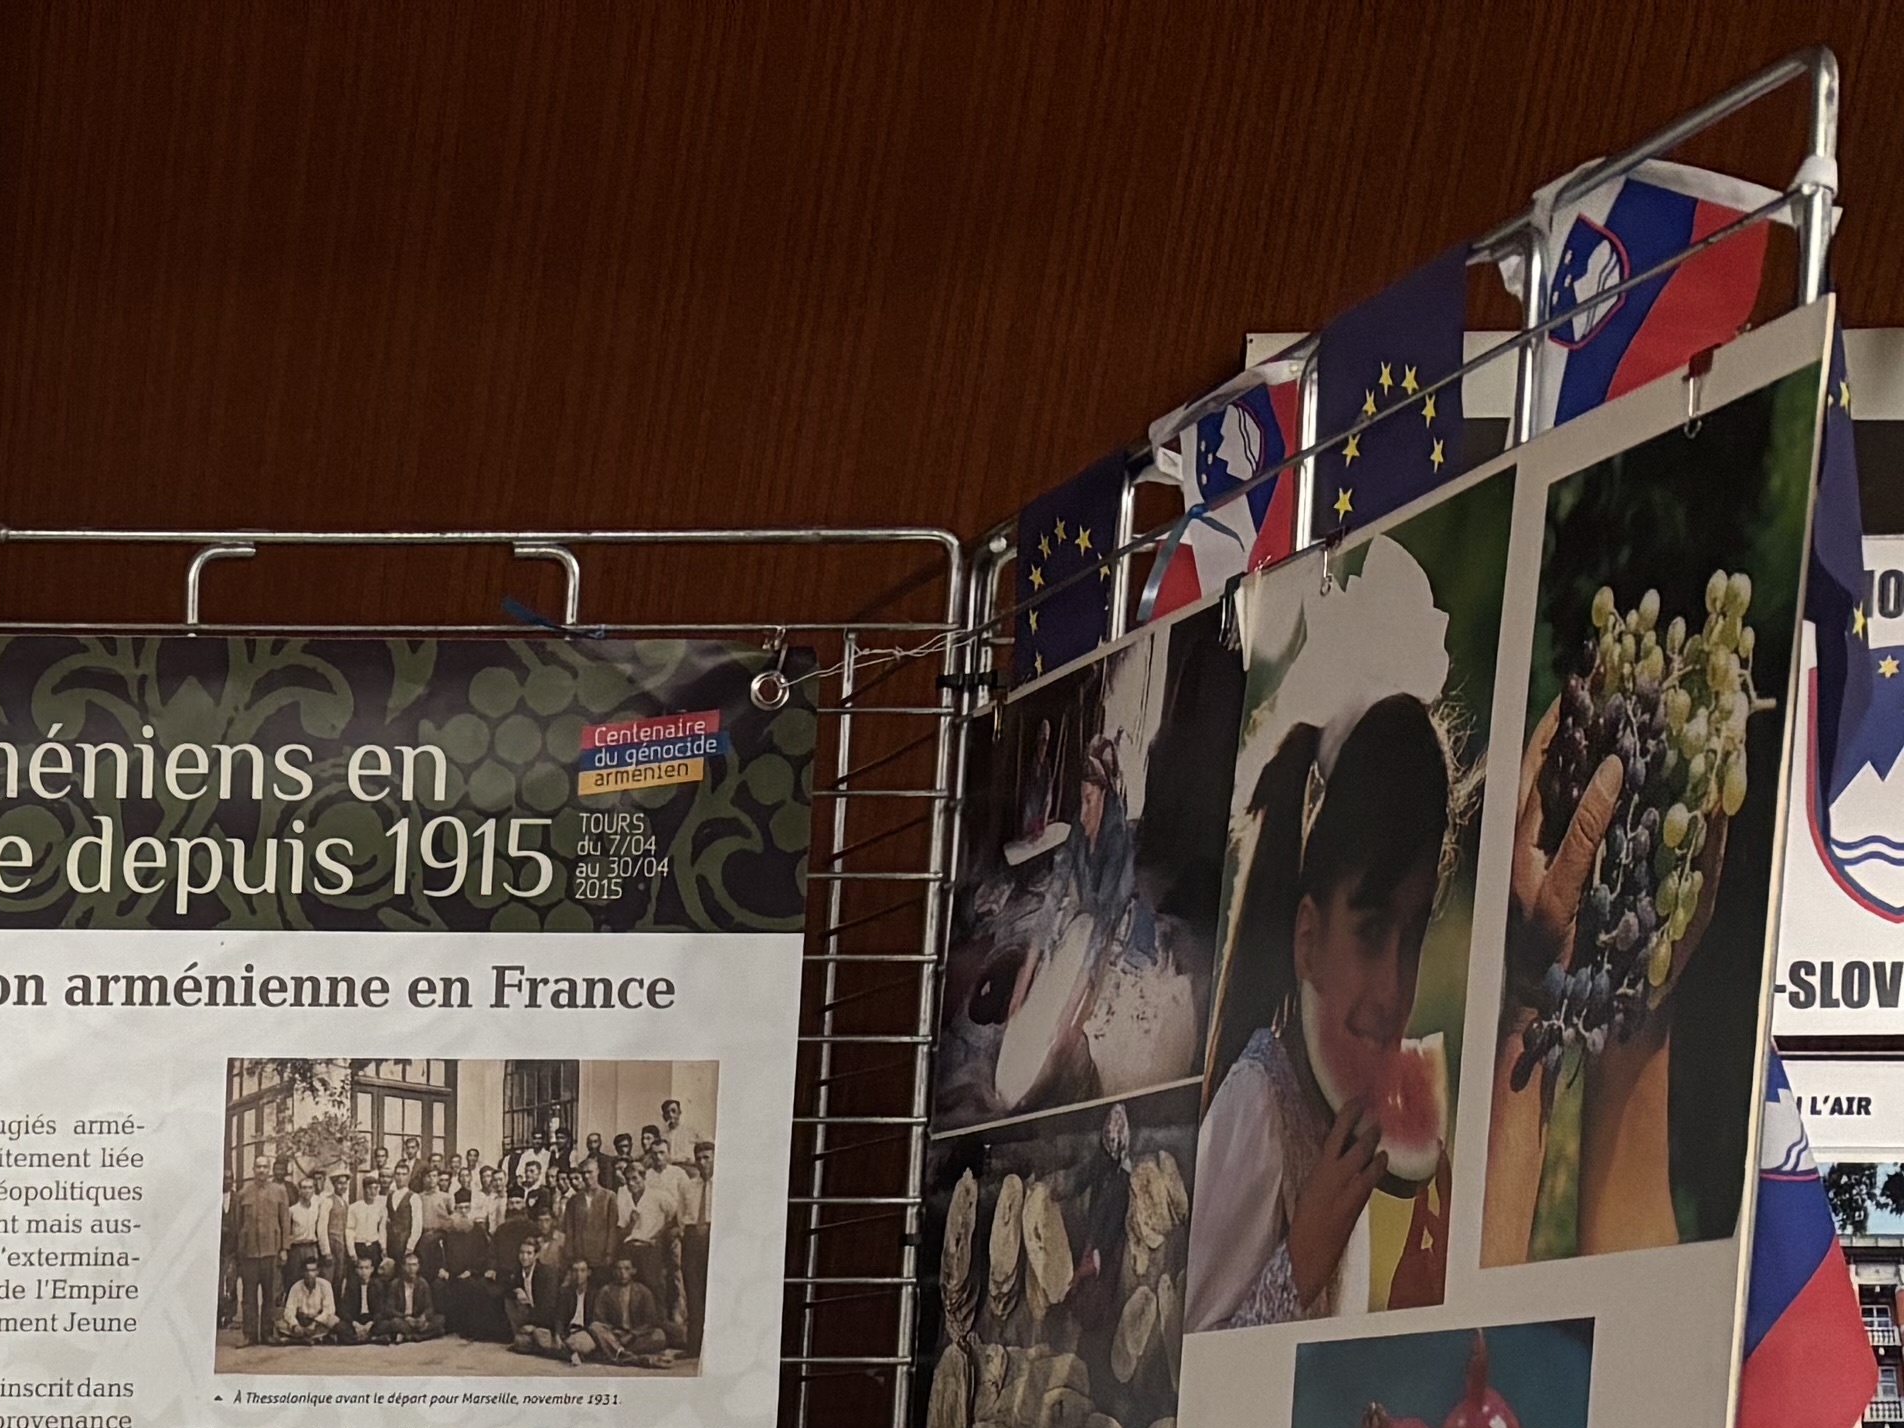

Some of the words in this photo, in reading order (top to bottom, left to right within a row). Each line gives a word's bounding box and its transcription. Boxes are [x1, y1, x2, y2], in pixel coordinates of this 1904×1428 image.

[346, 743, 448, 801] en
[65, 816, 355, 912] depuis
[386, 814, 553, 897] 1915
[65, 961, 390, 1008] arménienne
[409, 976, 472, 1008] en
[490, 965, 676, 1010] France
[1809, 1095, 1872, 1116] L'AIR
